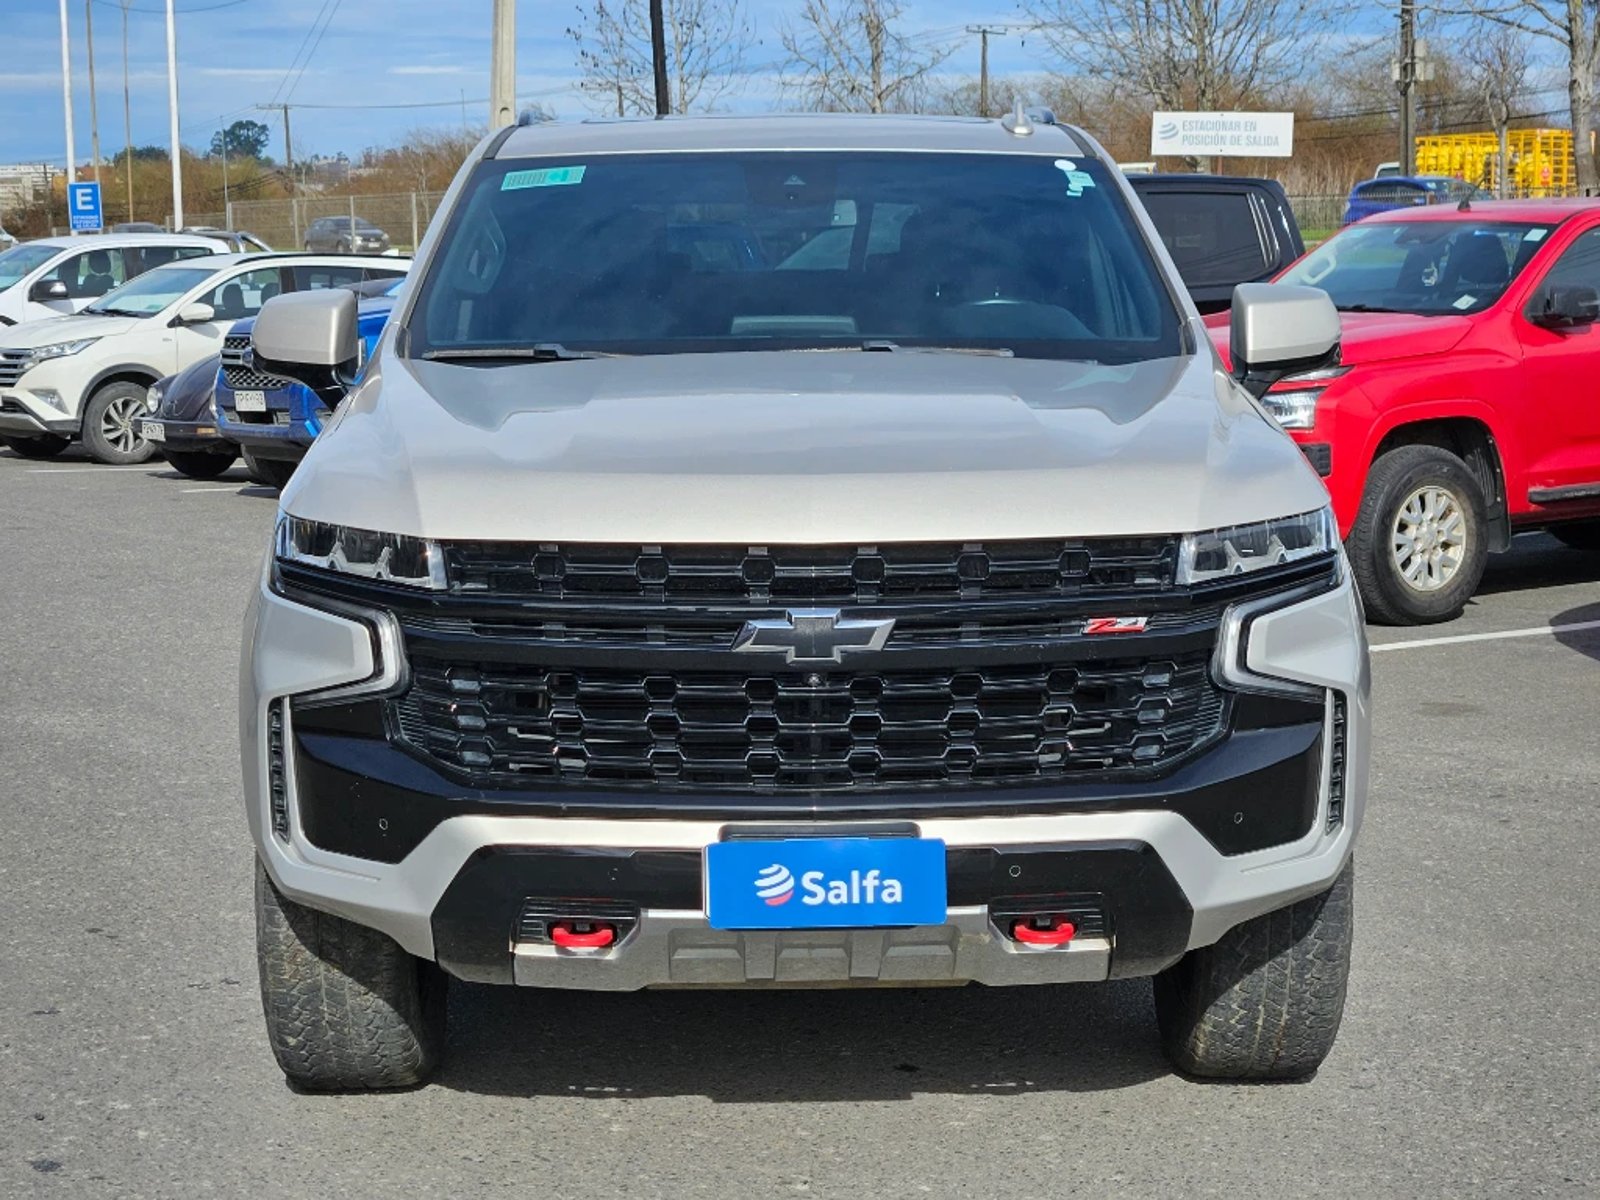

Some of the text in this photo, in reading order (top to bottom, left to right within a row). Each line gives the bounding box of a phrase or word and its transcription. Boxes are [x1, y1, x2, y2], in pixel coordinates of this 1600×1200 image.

[1182, 119, 1257, 132] ESTACIONAR EN
[1182, 132, 1279, 147] POSICIÓN DE SALIDA
[76, 188, 94, 210] E
[801, 869, 903, 906] Salfa
